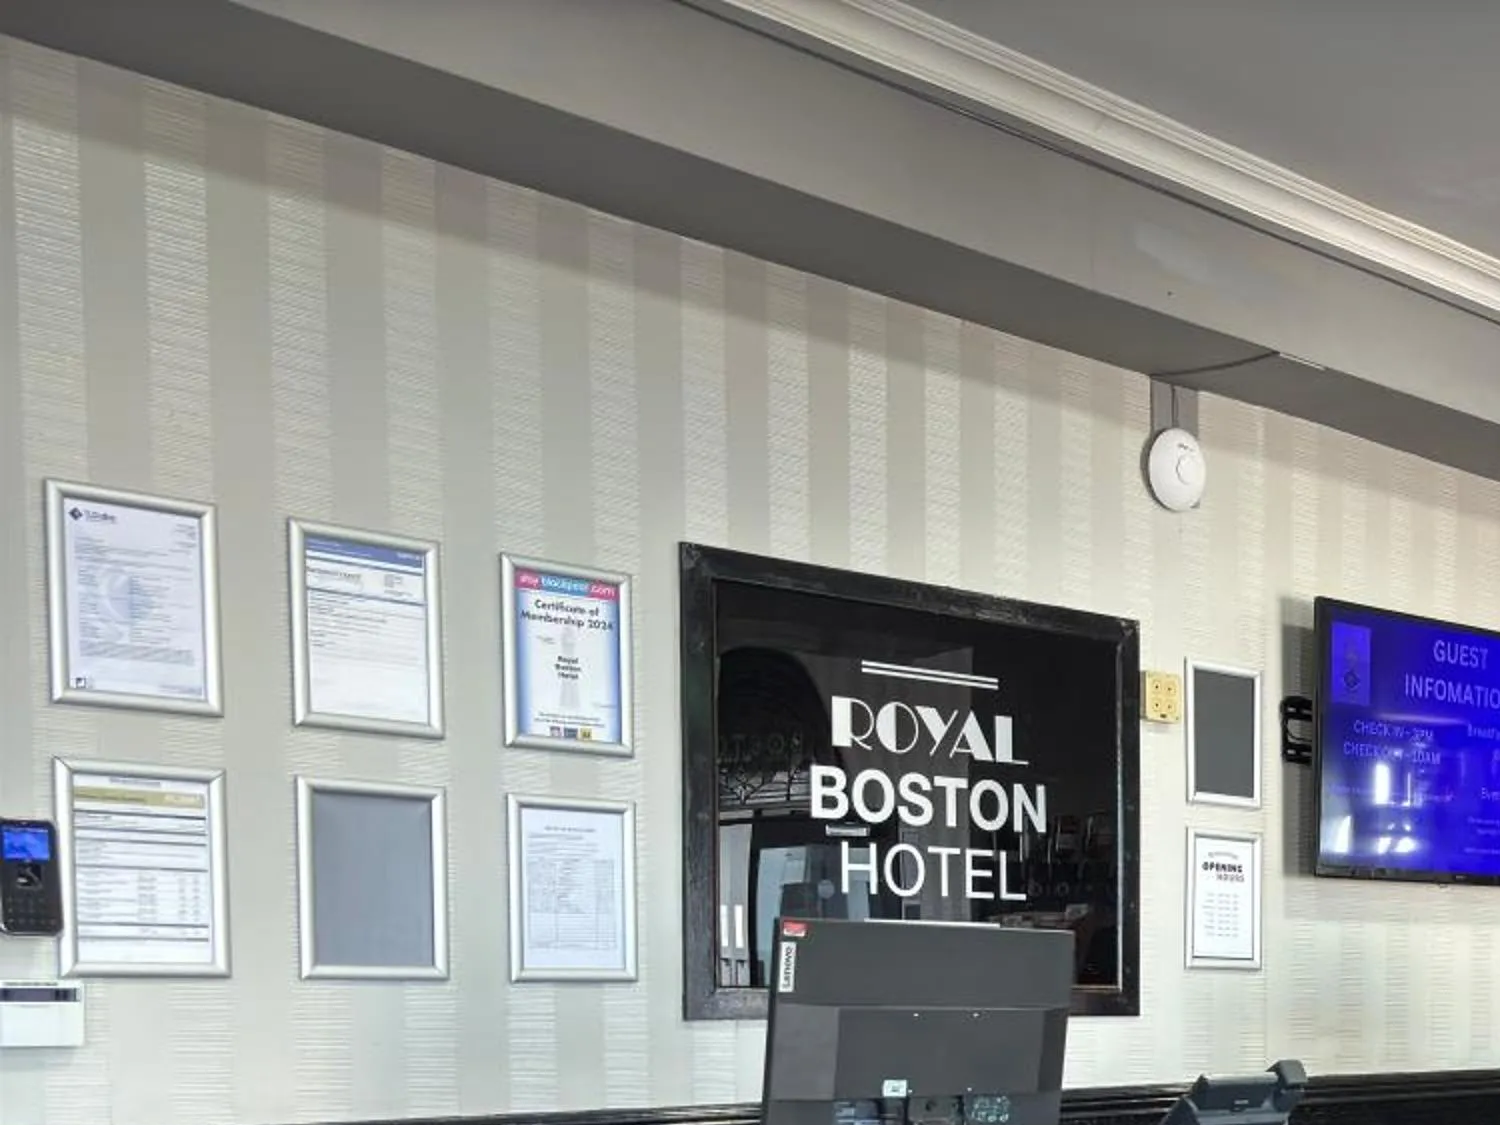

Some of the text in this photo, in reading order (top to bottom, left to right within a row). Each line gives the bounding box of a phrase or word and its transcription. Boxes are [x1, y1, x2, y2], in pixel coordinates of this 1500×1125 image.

[521, 609, 585, 628] Membership
[534, 599, 599, 616] Certificate of
[1433, 640, 1488, 669] GUEST
[831, 696, 1029, 765] ROYAL
[1353, 720, 1391, 737] CHECK
[810, 764, 1047, 833] BOSTON
[841, 842, 1027, 901] HOTEL
[782, 946, 793, 989] Lenovo
